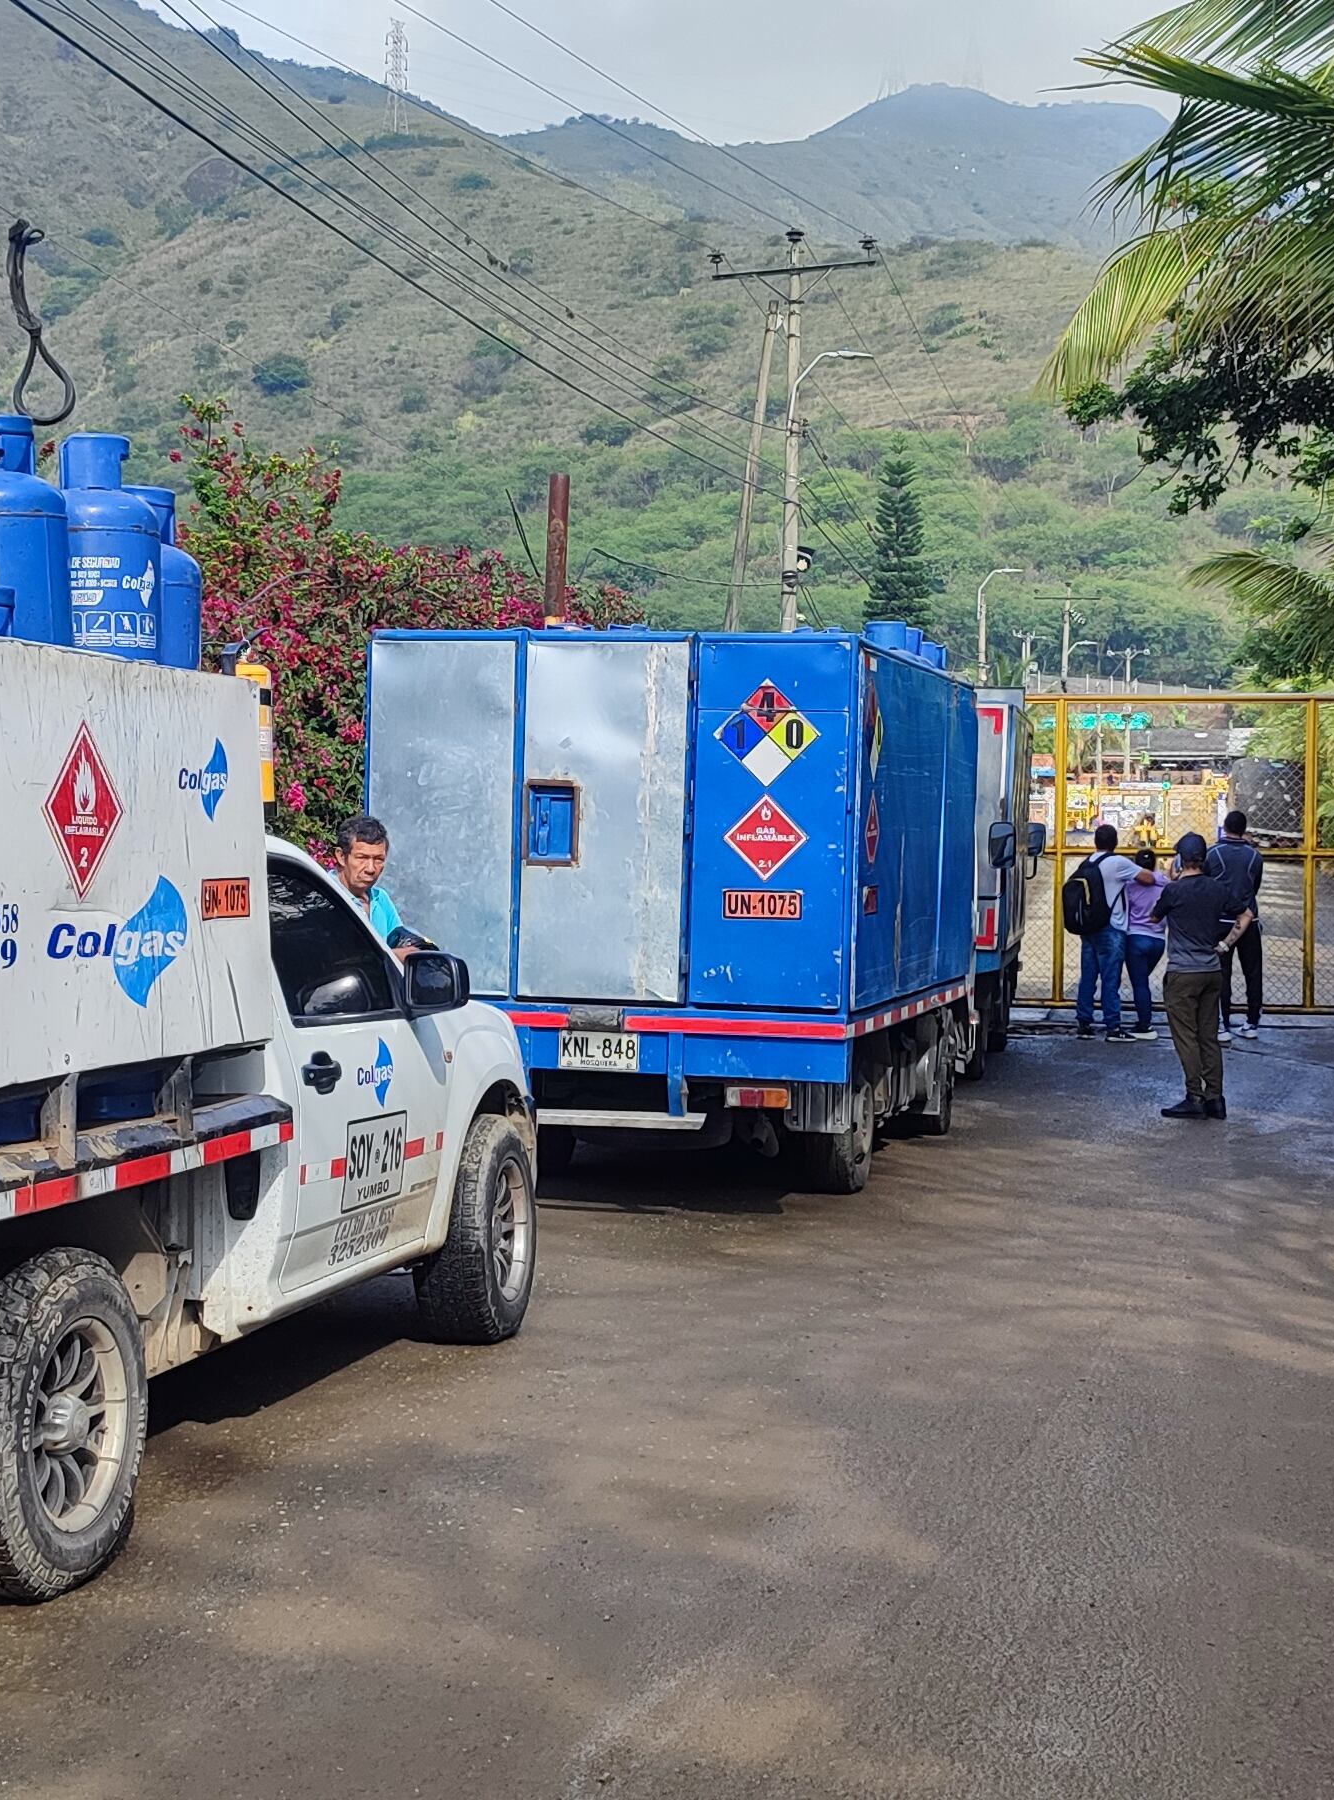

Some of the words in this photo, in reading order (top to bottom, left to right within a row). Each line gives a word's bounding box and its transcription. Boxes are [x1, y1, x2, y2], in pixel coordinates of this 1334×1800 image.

[757, 692, 777, 723] 4
[731, 719, 745, 750] 1
[785, 718, 804, 749] 0
[178, 767, 227, 795] Colgas
[736, 833, 796, 842] INFLAMABLE
[78, 846, 88, 868] 2
[727, 893, 798, 916] UN-1075
[46, 923, 185, 967] Colgas
[357, 1064, 394, 1088] Colgas
[357, 1178, 390, 1202] YUMBO
